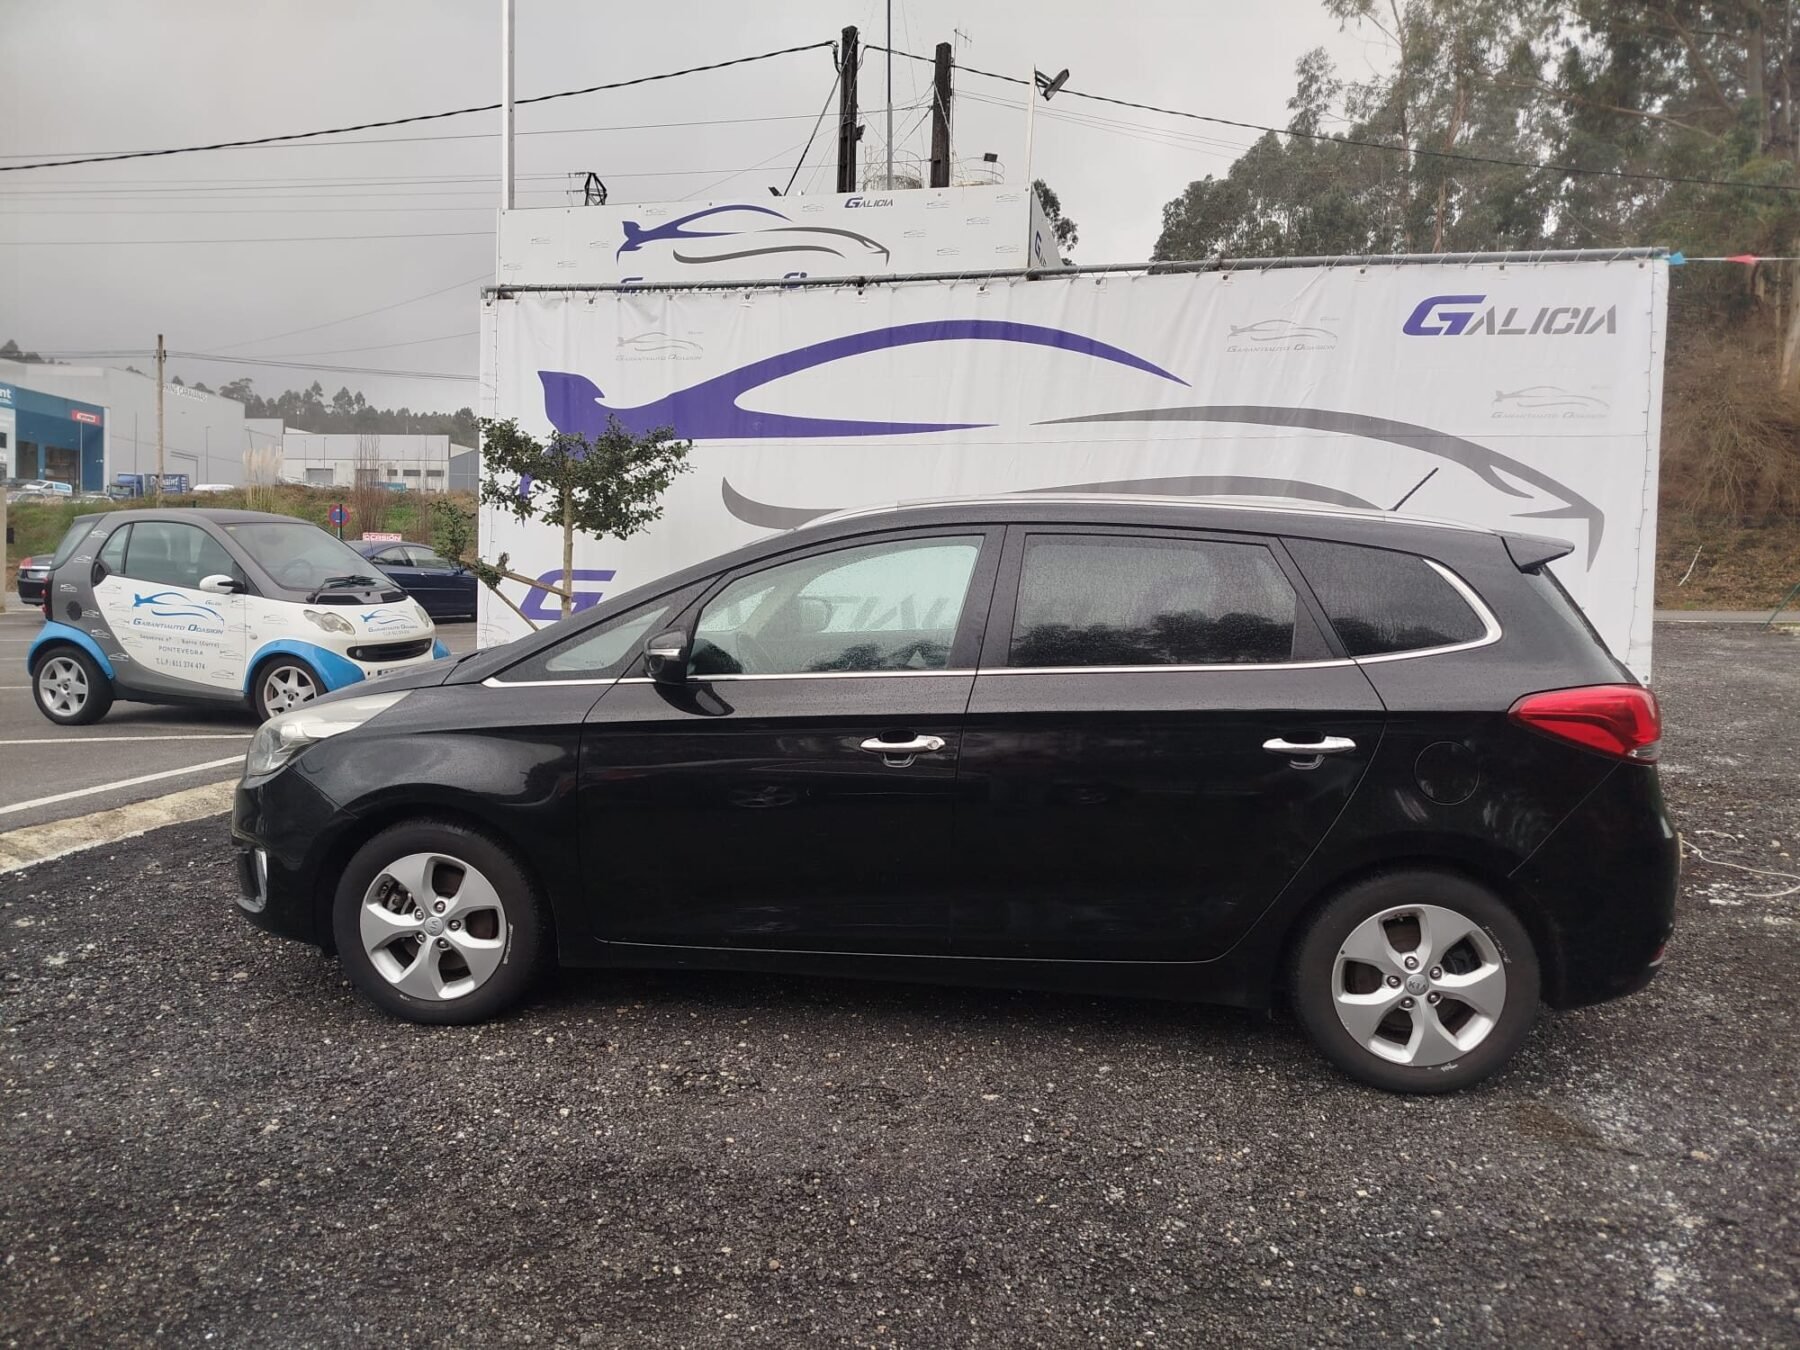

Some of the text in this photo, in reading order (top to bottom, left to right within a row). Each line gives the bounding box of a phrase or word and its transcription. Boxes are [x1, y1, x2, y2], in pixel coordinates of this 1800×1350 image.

[844, 196, 894, 208] GALICIA
[1402, 294, 1617, 336] GALICIA
[159, 646, 203, 655] PONTEVEDRA
